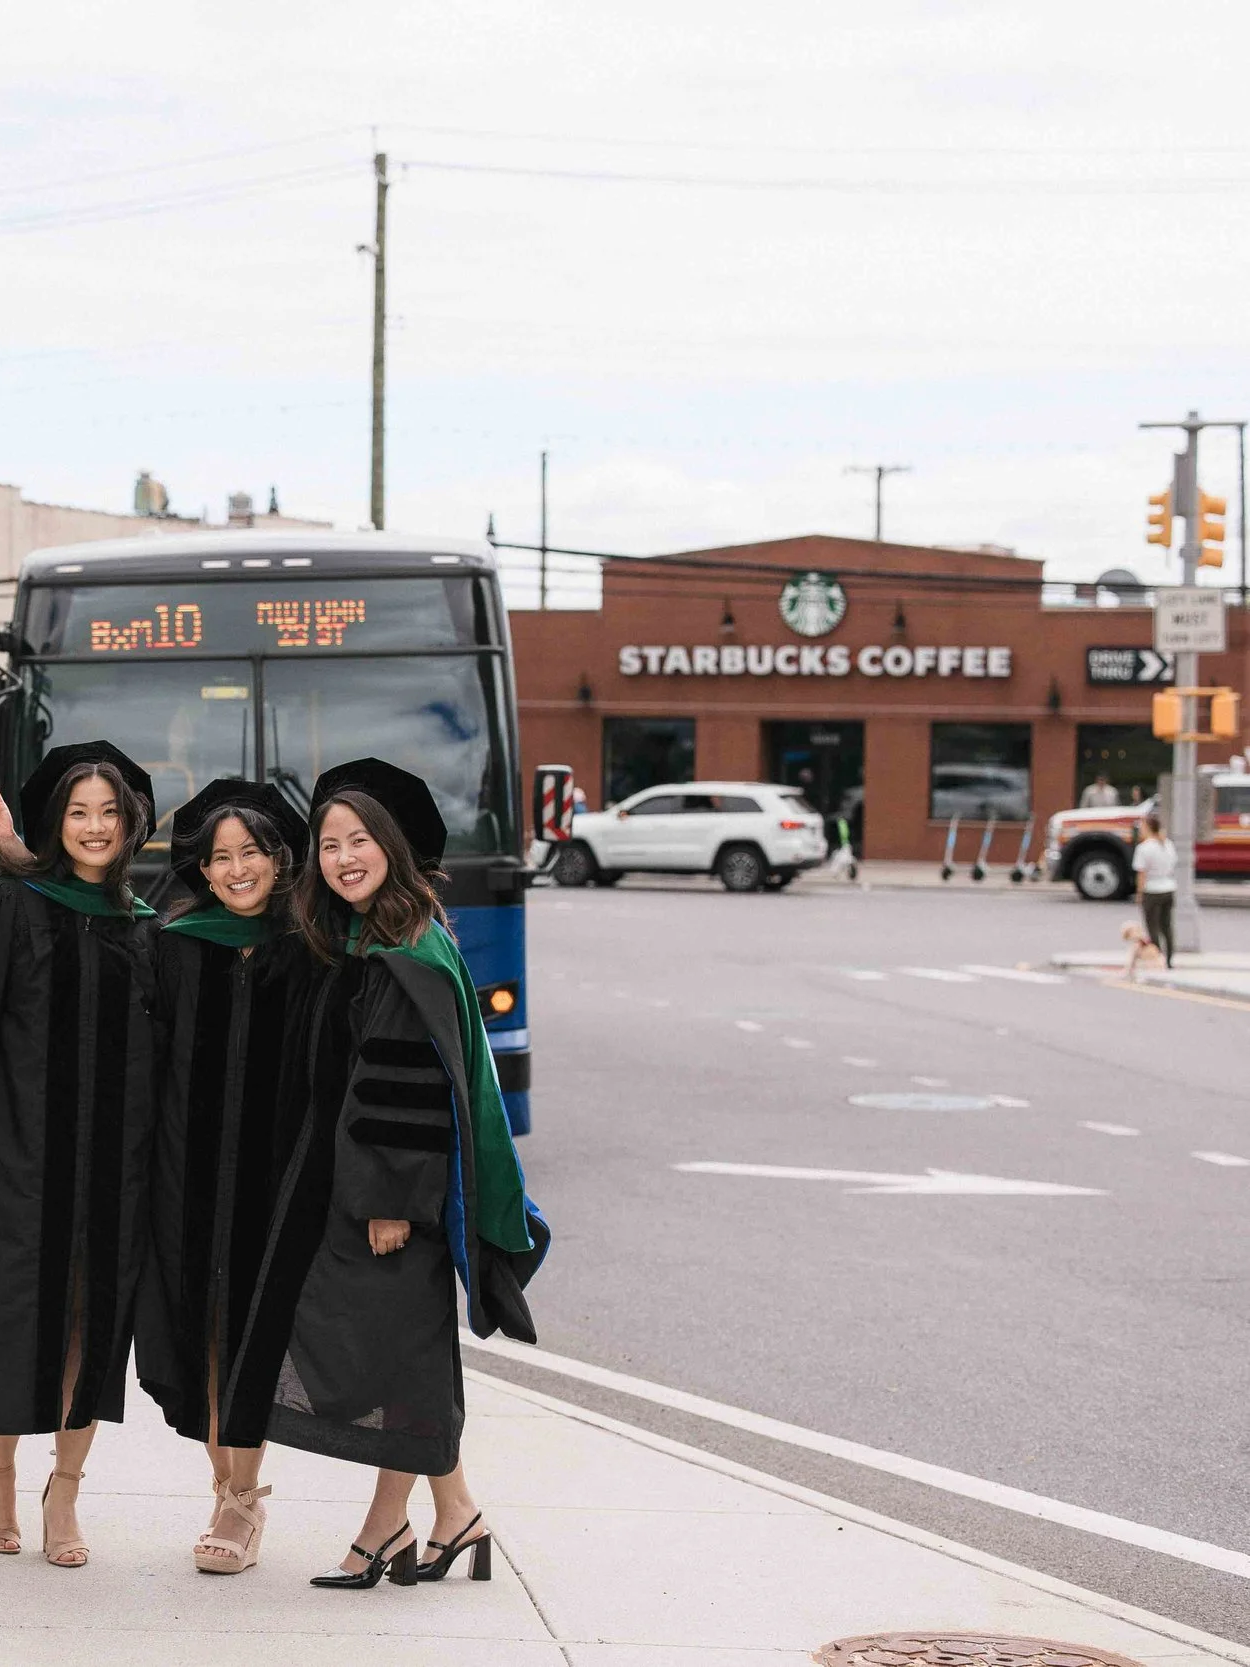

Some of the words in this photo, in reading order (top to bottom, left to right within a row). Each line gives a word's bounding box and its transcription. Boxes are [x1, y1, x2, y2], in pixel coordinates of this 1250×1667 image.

[1171, 612, 1207, 625] MUST
[91, 603, 202, 651] BxM10
[618, 645, 849, 676] STARBUCKS
[857, 645, 1012, 677] COFFEE
[1089, 650, 1135, 666] DRIVE
[1090, 665, 1134, 680] THRU
